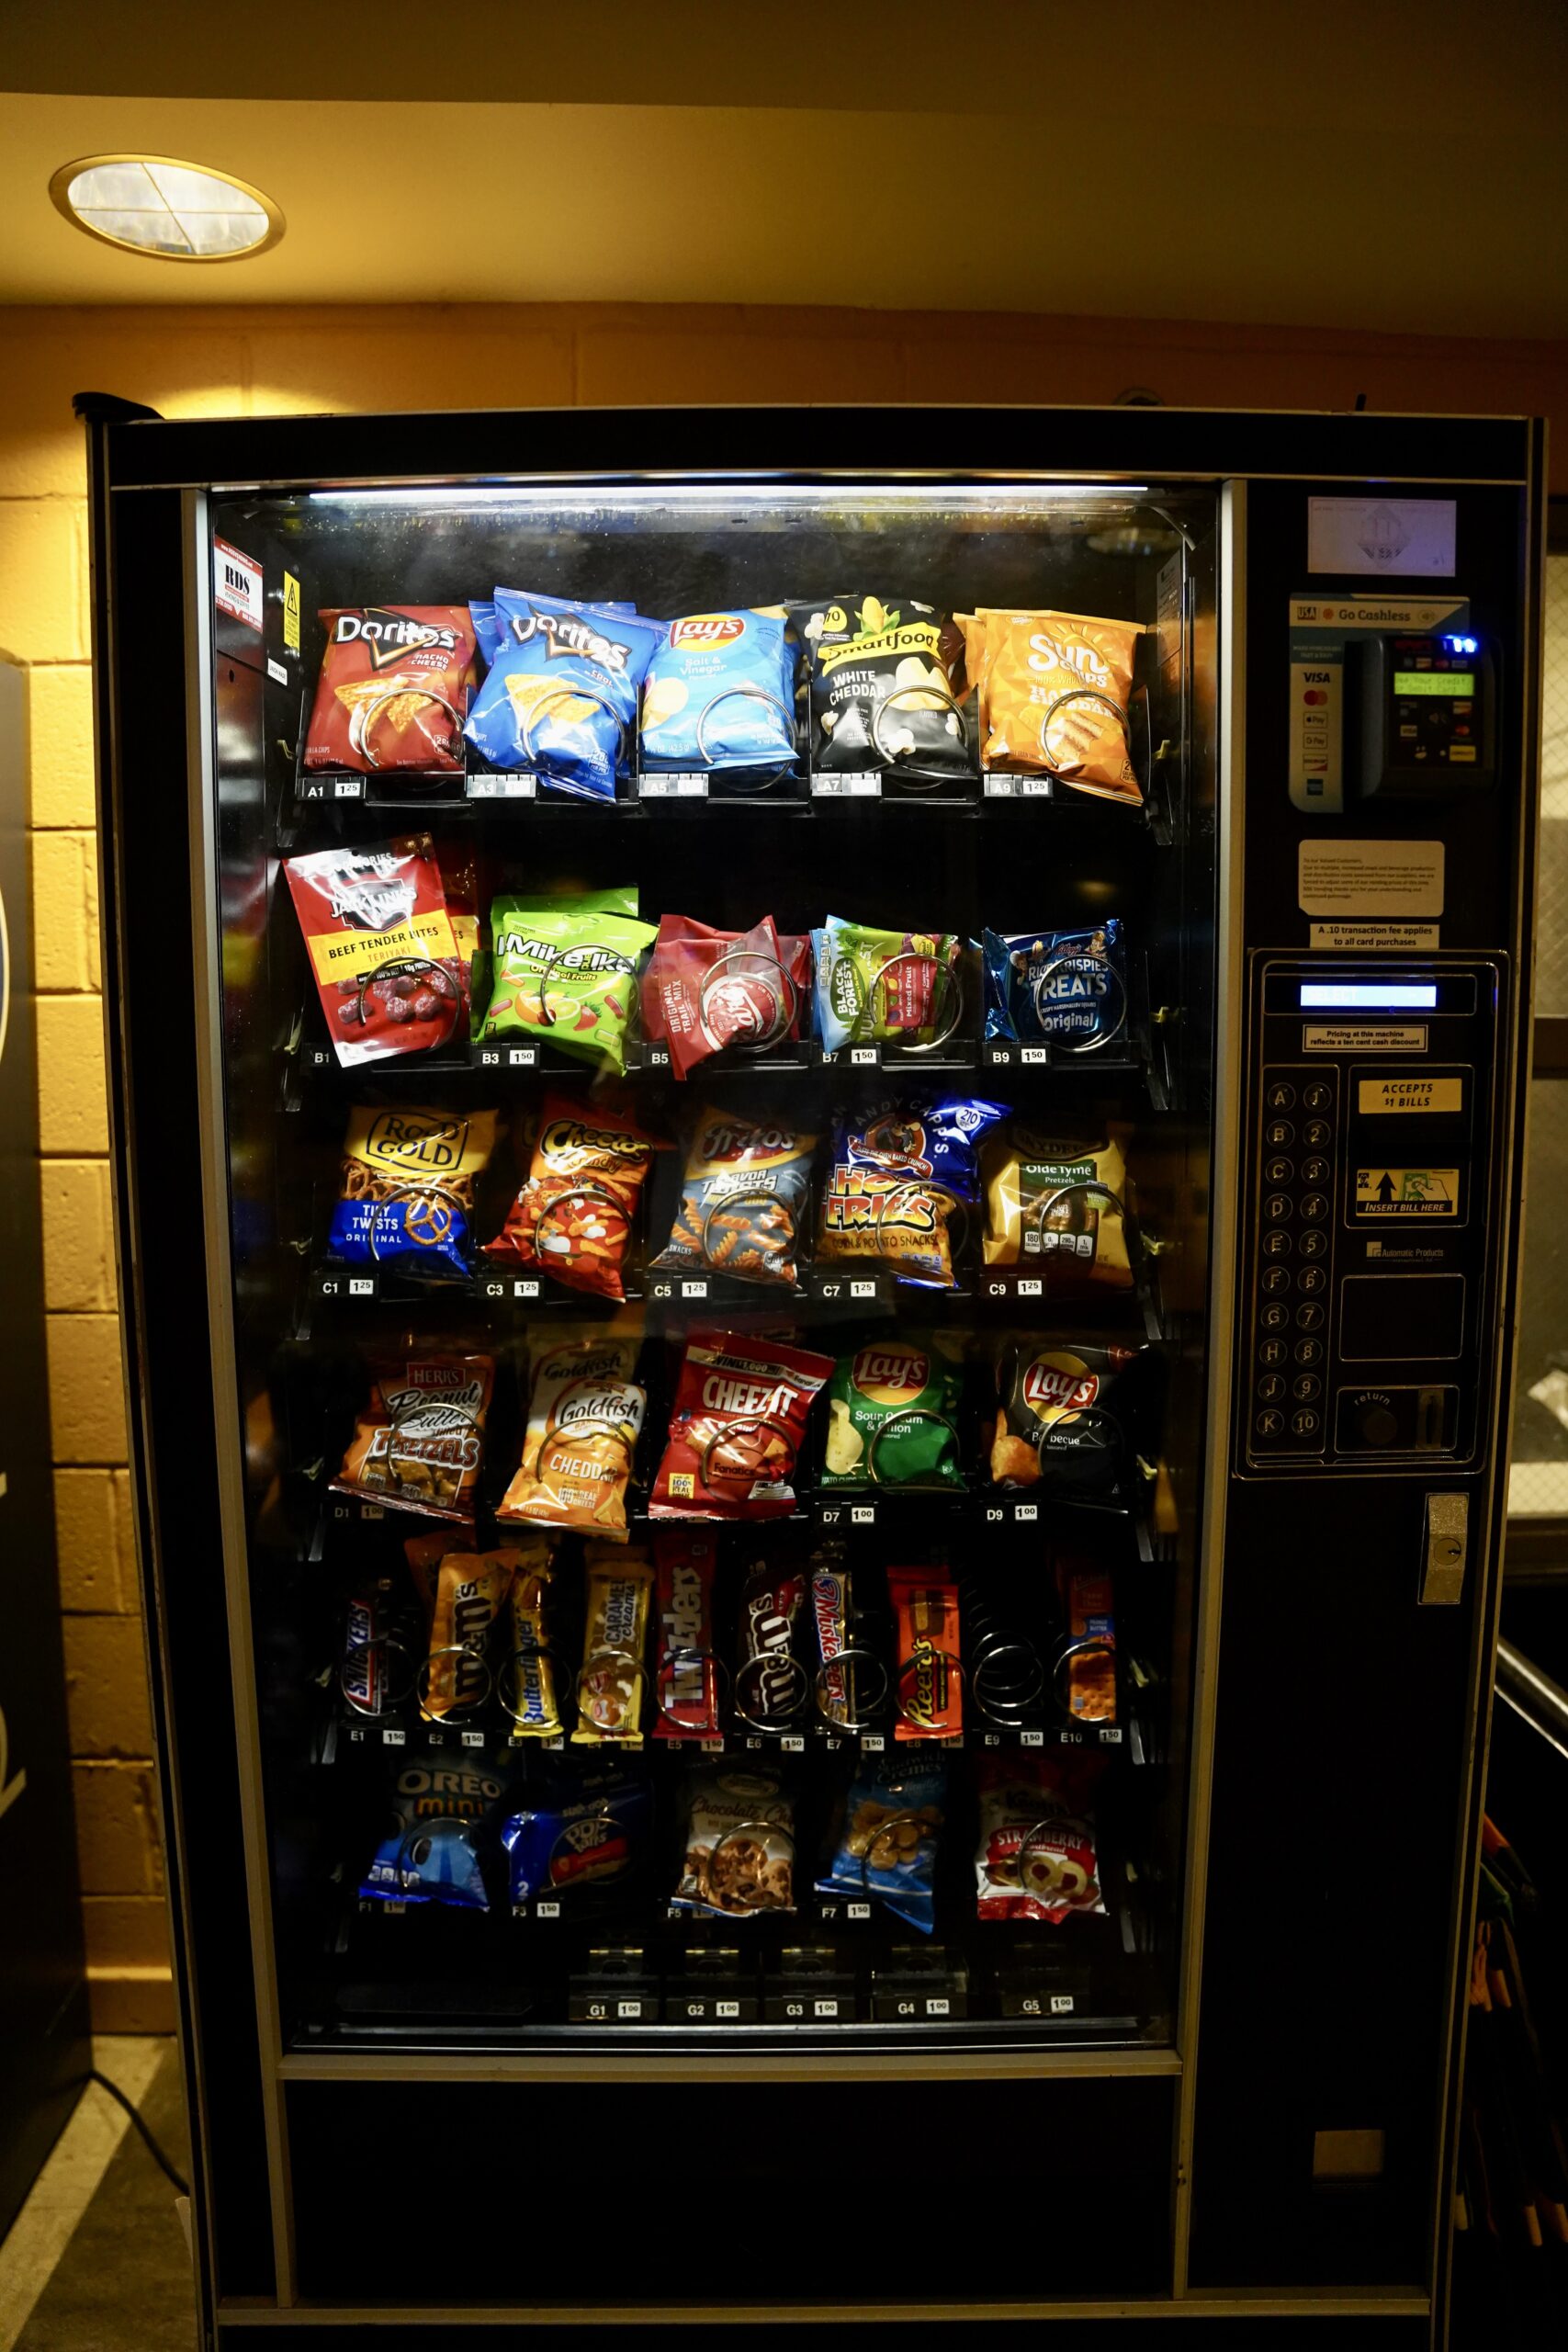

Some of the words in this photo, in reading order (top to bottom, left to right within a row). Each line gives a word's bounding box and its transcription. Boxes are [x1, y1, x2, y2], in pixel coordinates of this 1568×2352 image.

[225, 564, 250, 595] RDS
[1298, 607, 1315, 619] USA
[1339, 609, 1355, 620] Go
[1358, 610, 1411, 621] Cashless
[337, 616, 455, 648] Doritos
[671, 618, 739, 648] Lay's
[513, 616, 630, 669] Doritos
[829, 630, 933, 661] Smartfood
[1028, 634, 1110, 674] Sun
[412, 659, 447, 671] CHEESE
[685, 658, 710, 666] Salt
[680, 663, 727, 675] Vinegar
[592, 669, 614, 689] COOL
[833, 671, 875, 687] WHITE
[1304, 672, 1330, 683] VISA
[829, 684, 886, 707] CHEDDAR
[308, 787, 323, 797] A1
[477, 783, 494, 794] A3
[649, 783, 667, 793] A5
[823, 781, 840, 791] A7
[995, 785, 1010, 794] A9
[1327, 926, 1339, 934] .10
[1341, 926, 1387, 934] transaction
[1389, 926, 1402, 934] fee
[1404, 926, 1433, 936] applies
[329, 944, 356, 958] BEEF
[359, 933, 406, 950] TENDER
[1376, 938, 1416, 947] purchases
[368, 946, 411, 963] TERIYAKI
[507, 933, 579, 968] Mike
[571, 973, 597, 981] Fruits
[836, 966, 847, 1014] BLACK
[843, 962, 859, 1016] FOREST
[1031, 972, 1107, 1003] TREATS
[663, 984, 682, 1033] ORIGINAL
[680, 1004, 692, 1033] TRAIL
[1043, 1012, 1094, 1032] Original
[314, 1053, 330, 1063] B1
[482, 1053, 499, 1064] B3
[651, 1054, 668, 1064] B5
[823, 1052, 839, 1062] B7
[993, 1052, 1010, 1062] B9
[1382, 1083, 1433, 1094] ACCEPTS
[1275, 1091, 1286, 1104] A
[1313, 1091, 1319, 1104] 1
[1384, 1098, 1394, 1107] $1
[1399, 1098, 1430, 1107] BILLS
[960, 1109, 977, 1125] 210
[386, 1117, 459, 1140] ROLD
[1273, 1127, 1285, 1141] B
[1311, 1128, 1320, 1142] 2
[704, 1125, 795, 1158] Fritos
[377, 1140, 452, 1166] GOLD
[568, 1154, 621, 1174] Crunchy
[1026, 1165, 1057, 1174] Olde
[1057, 1165, 1091, 1177] Tyme
[1273, 1165, 1284, 1178] C
[1310, 1165, 1319, 1178] 3
[827, 1196, 936, 1228] FRIES
[1272, 1202, 1283, 1216] D
[1308, 1202, 1317, 1215] 4
[1365, 1203, 1399, 1213] INSERT
[1400, 1204, 1419, 1212] BILL
[1421, 1204, 1445, 1212] HERE
[353, 1217, 398, 1229] TWSTS
[346, 1233, 401, 1243] ORIINAL
[900, 1235, 936, 1246] SNACKS
[1027, 1233, 1038, 1242] 180
[669, 1244, 692, 1255] SNACKS
[1271, 1238, 1281, 1251] E
[1308, 1238, 1316, 1252] 5
[1382, 1248, 1414, 1257] Automatic
[1416, 1248, 1444, 1257] Products
[1270, 1273, 1280, 1287] F
[1305, 1273, 1315, 1287] 6
[322, 1283, 338, 1294] C1
[486, 1284, 503, 1295] C3
[654, 1285, 671, 1296] C5
[823, 1285, 840, 1296] C7
[989, 1284, 1006, 1295] C9
[1268, 1310, 1280, 1324] G
[1305, 1309, 1314, 1323] 7
[1267, 1346, 1278, 1359] H
[1303, 1345, 1313, 1359] 8
[545, 1353, 622, 1380] Goldfish
[858, 1353, 925, 1388] Lay's
[414, 1369, 460, 1384] HERR'S
[1267, 1381, 1276, 1396] J
[1303, 1381, 1312, 1395] 9
[388, 1381, 481, 1412] Peanut
[1353, 1391, 1392, 1407] return
[560, 1396, 638, 1424] Goldfish
[855, 1411, 883, 1421] Sour
[866, 1421, 875, 1430] &
[1265, 1416, 1275, 1430] K
[1298, 1416, 1314, 1430] 10
[715, 1463, 754, 1476] Fanatics
[334, 1508, 349, 1518] D1
[823, 1511, 840, 1522] D7
[987, 1510, 1003, 1521] D9
[813, 1577, 840, 1600] 3
[605, 1579, 626, 1643] CARAMEL
[907, 1638, 933, 1724] Reese's
[350, 1731, 365, 1741] E1
[429, 1734, 444, 1744] E2
[747, 1737, 761, 1748] E6
[985, 1735, 999, 1746] E9
[1060, 1732, 1083, 1743] E10
[827, 1739, 841, 1749] E7
[397, 1768, 501, 1800] OREO
[416, 1796, 484, 1817] mini
[690, 1795, 762, 1820] Chocolate
[998, 1828, 1086, 1850] STRAWBERRY
[517, 1880, 529, 1896] 2
[359, 1902, 371, 1913] F1
[512, 1905, 527, 1917] F3
[668, 1907, 682, 1918] F5
[822, 1906, 837, 1918] F7
[590, 2005, 605, 2016] G1
[688, 2005, 705, 2016] G2
[786, 2004, 804, 2016] G3
[898, 2002, 915, 2014] G4
[1022, 1999, 1040, 2011] G5
